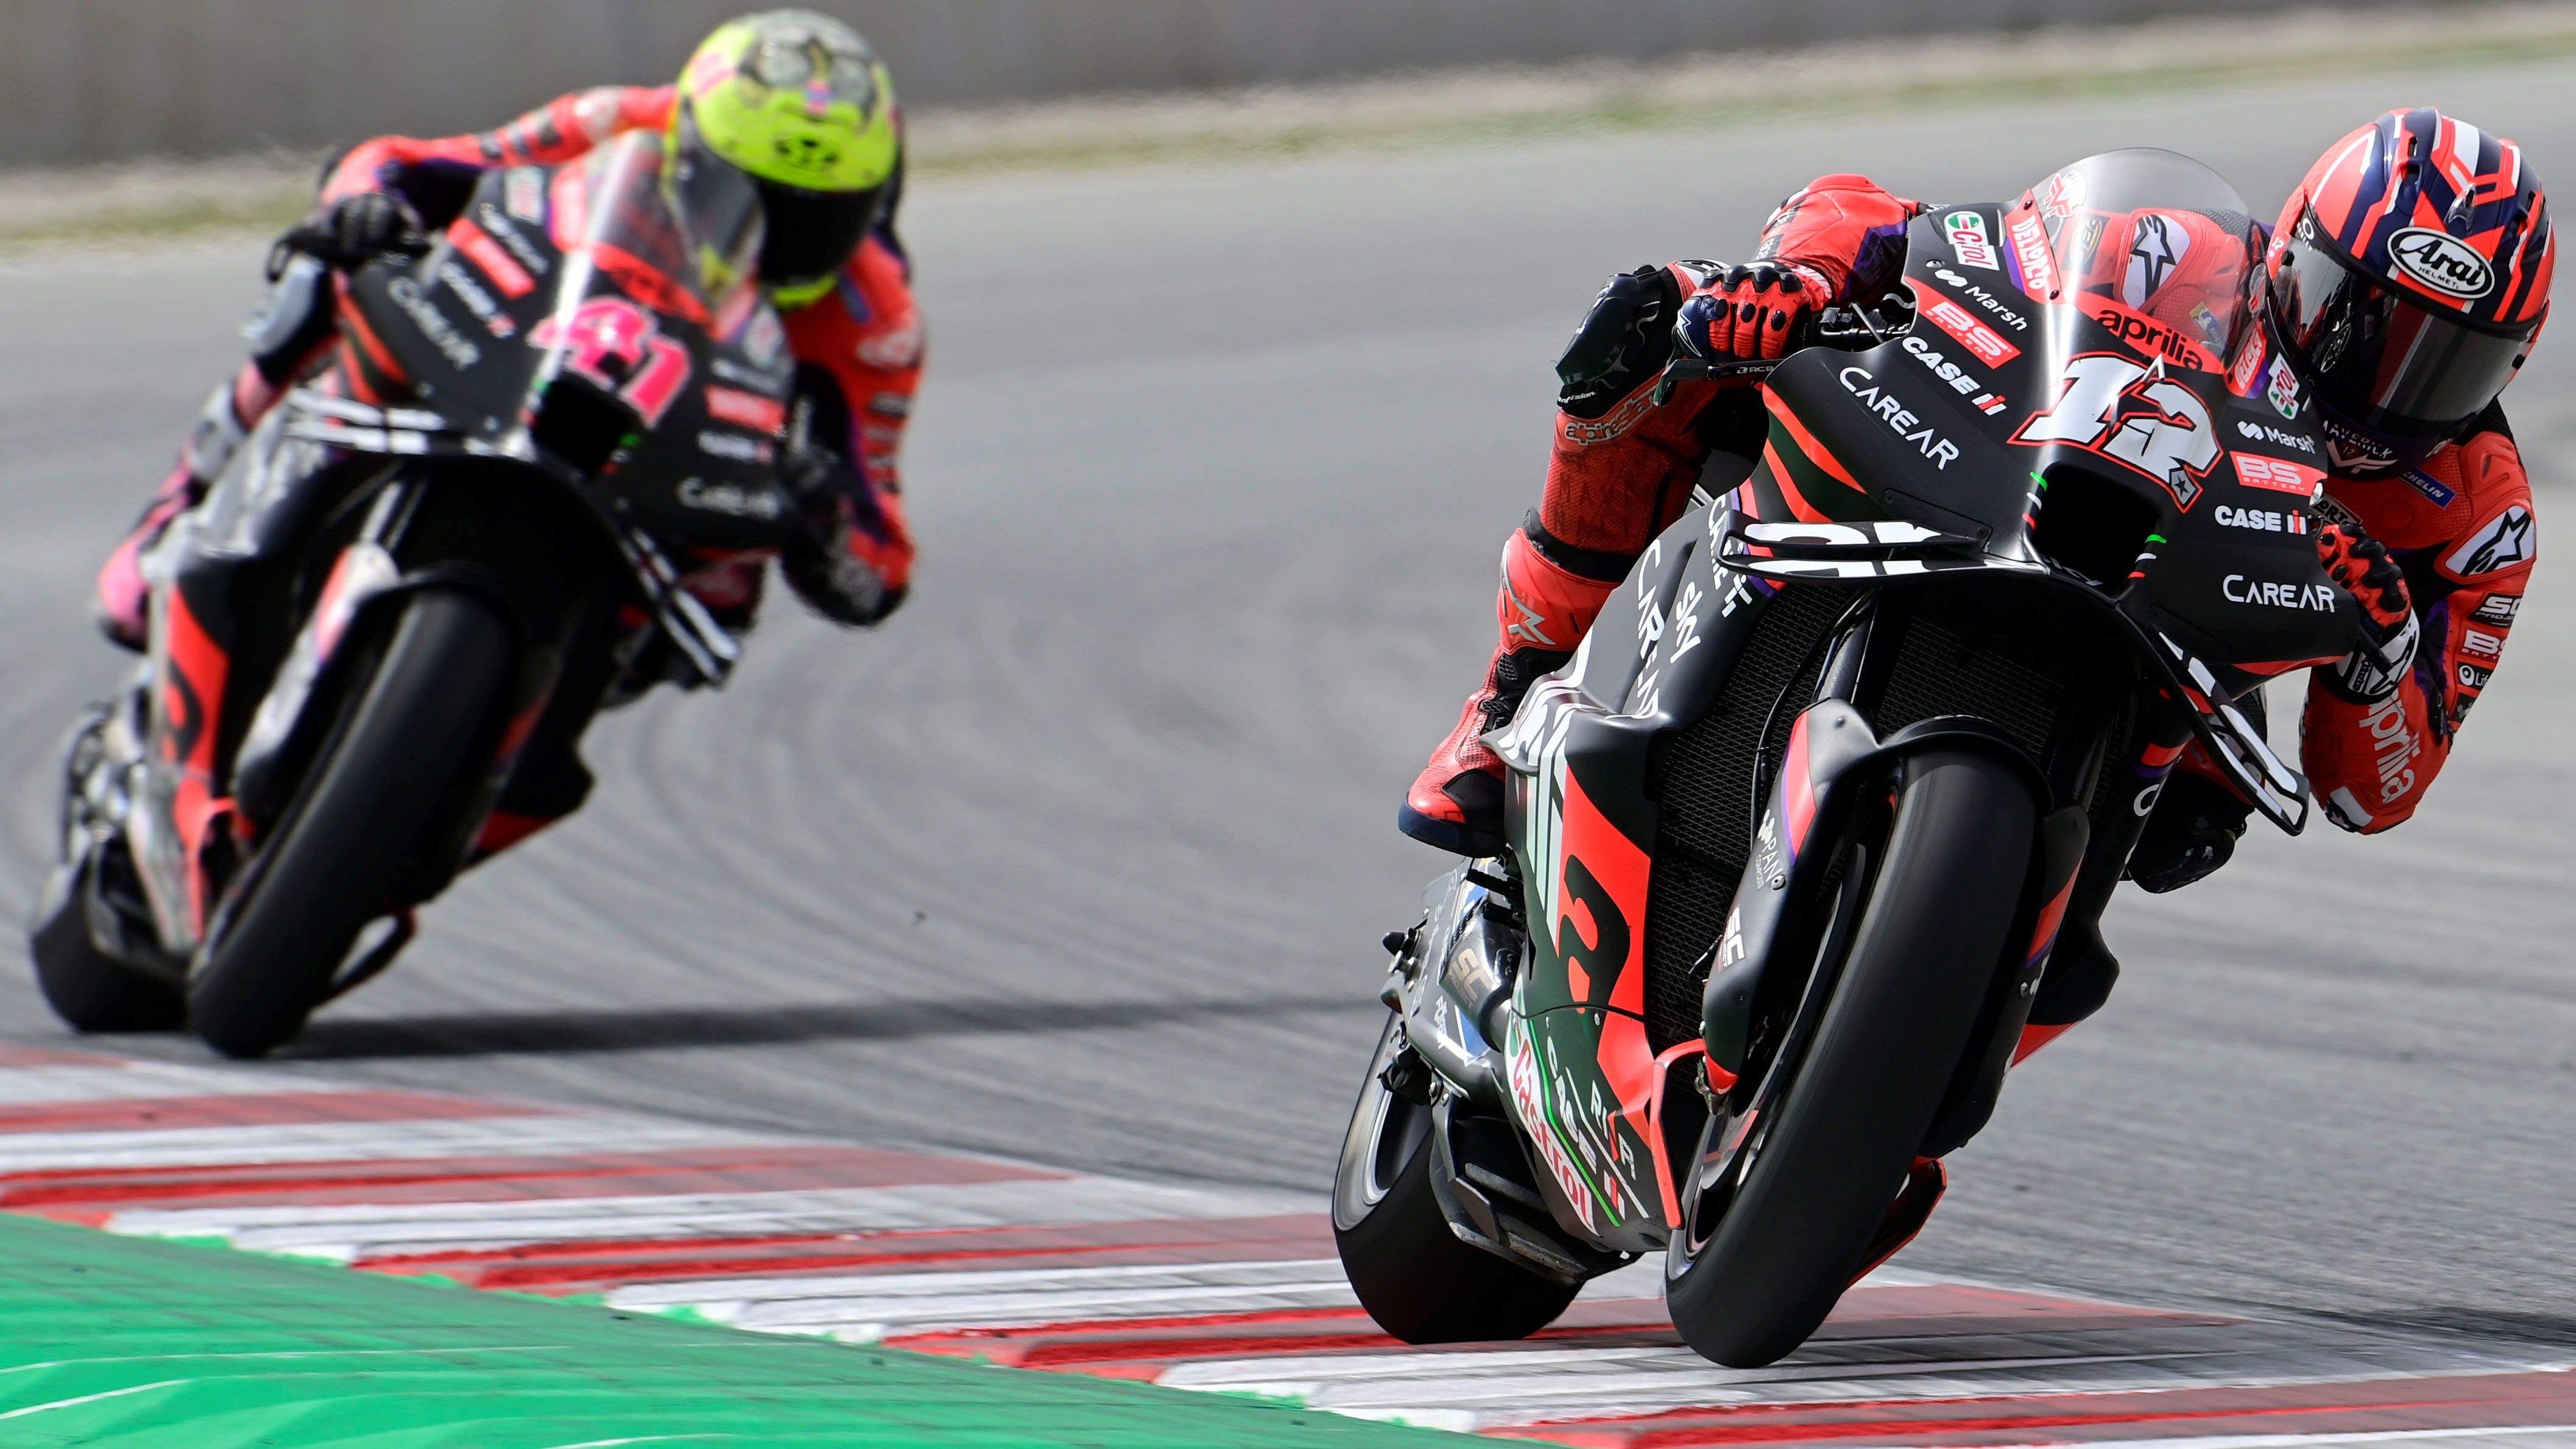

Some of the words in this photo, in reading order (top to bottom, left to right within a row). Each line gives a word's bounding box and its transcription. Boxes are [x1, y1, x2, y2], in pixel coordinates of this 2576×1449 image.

[2394, 239, 2485, 286] Arai
[2418, 267, 2457, 287] HELMET
[1930, 301, 2008, 356] BS
[1964, 286, 2027, 331] Marsh
[527, 296, 690, 429] 41
[2099, 309, 2203, 372] aprilia
[1902, 337, 1981, 395] CASE
[1840, 367, 1960, 471] CAREAR
[2015, 354, 2222, 508] 12
[2264, 426, 2315, 454] Marsh
[2236, 456, 2301, 485] BS
[2243, 477, 2305, 492] BATTERY
[2403, 471, 2444, 498] CHELIN
[2215, 505, 2281, 532] CASE
[2223, 574, 2335, 613] CAREAR
[1452, 948, 1494, 1001] SC
[1547, 1036, 1597, 1175] CASE
[1513, 1038, 1587, 1225] Castrol
